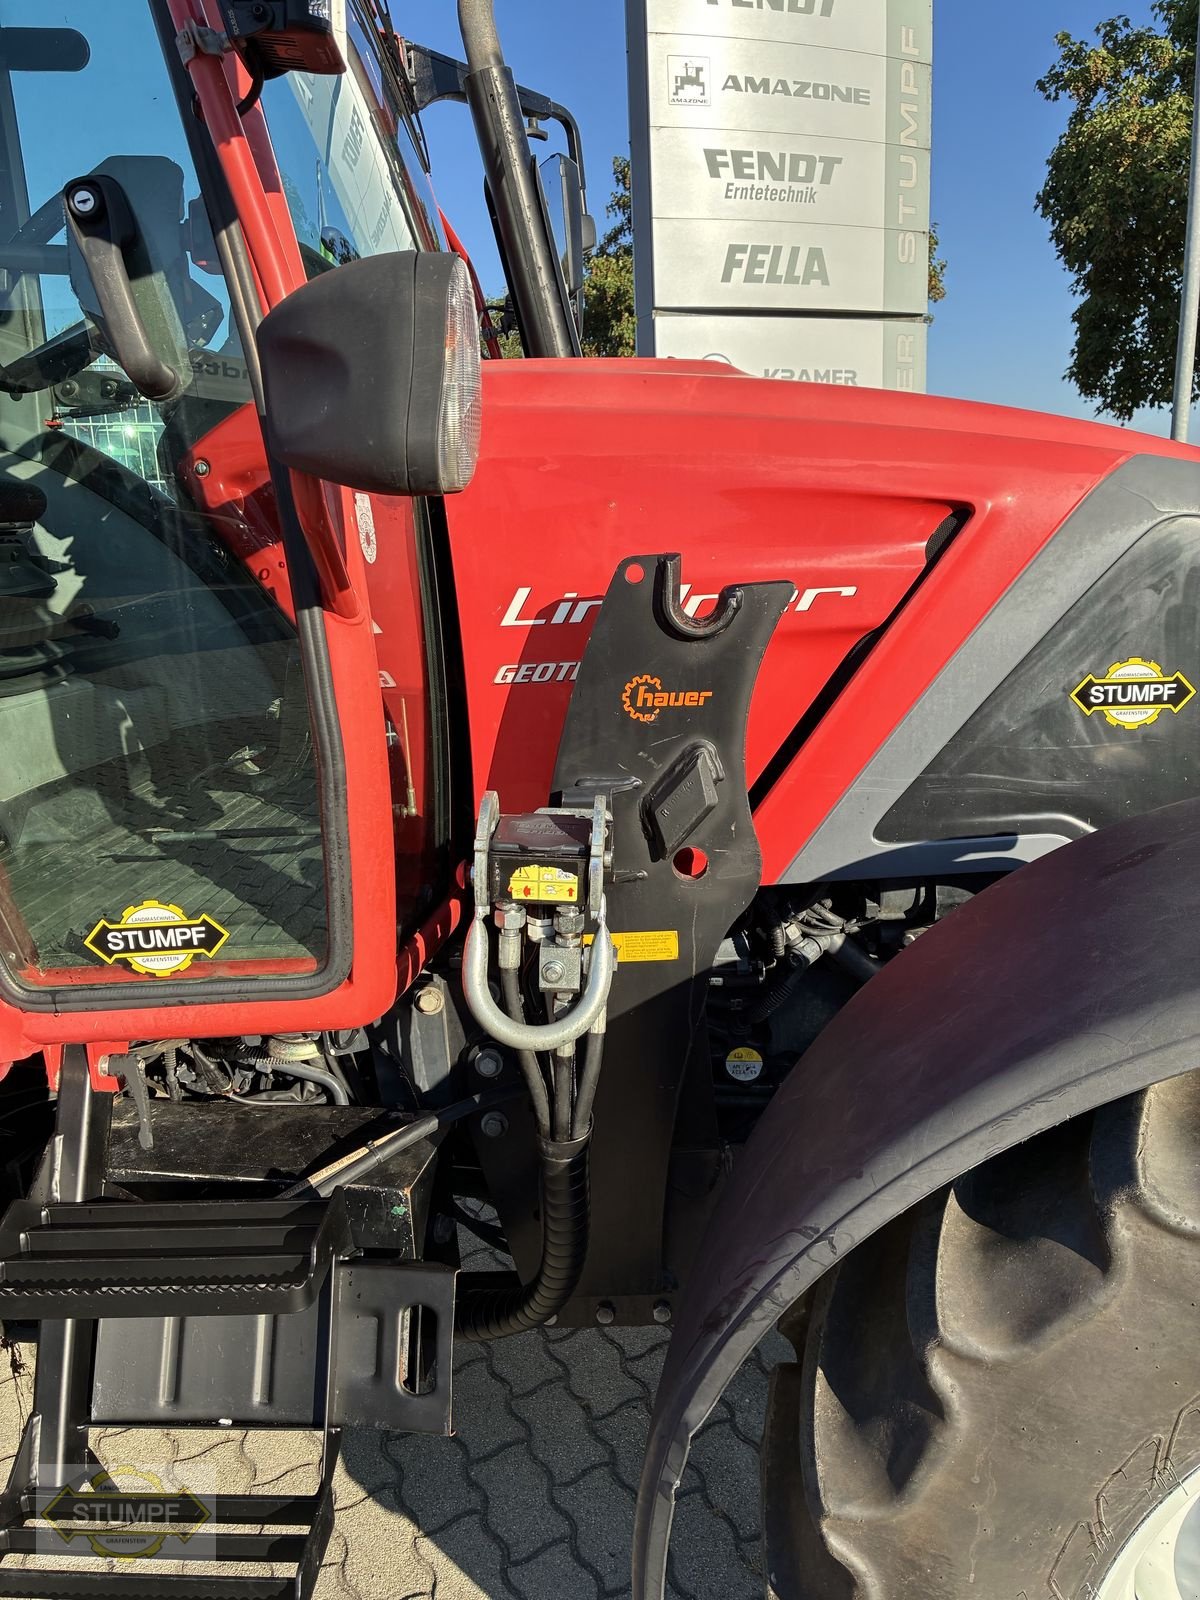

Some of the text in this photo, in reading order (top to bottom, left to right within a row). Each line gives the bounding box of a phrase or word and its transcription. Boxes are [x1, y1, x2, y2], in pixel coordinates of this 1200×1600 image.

[721, 74, 871, 106] AMAZONE
[899, 26, 920, 265] STUMPF
[703, 148, 843, 185] FENDT
[724, 183, 817, 204] Erntetechnik
[720, 243, 831, 287] FELLA
[763, 368, 858, 386] KRAMER
[636, 685, 713, 707] hauer
[1089, 683, 1177, 704] STUMPF
[106, 926, 206, 951] STUMPF
